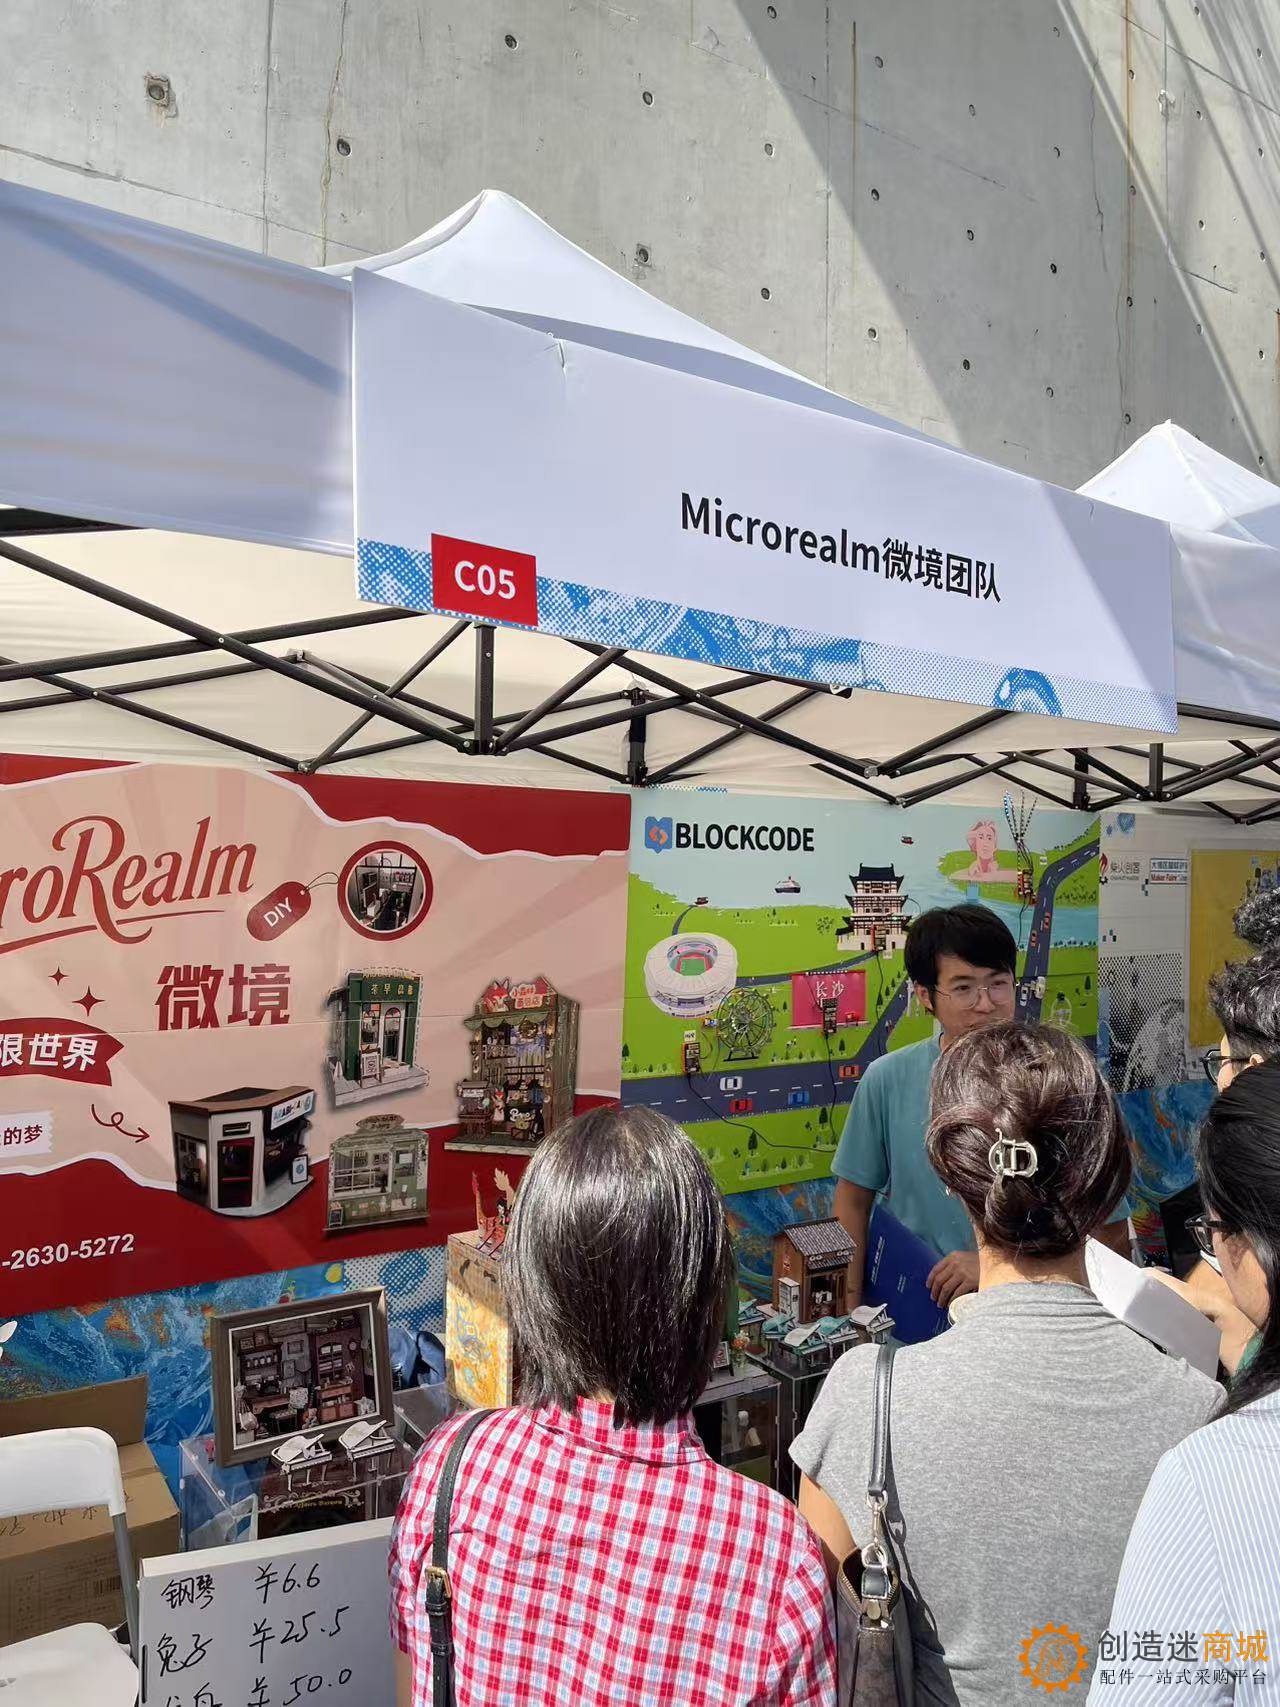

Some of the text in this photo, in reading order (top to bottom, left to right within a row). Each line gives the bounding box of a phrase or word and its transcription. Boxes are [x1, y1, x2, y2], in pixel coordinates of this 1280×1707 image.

[680, 492, 1001, 604] Microrealm微境团队
[454, 560, 516, 601] C05
[675, 822, 815, 853] BLOCKCODE
[263, 896, 292, 927] DIY
[156, 962, 291, 1031] 微境
[815, 980, 845, 998] 长沙
[0, 1032, 98, 1072] 限世界
[0, 1124, 43, 1146] 的梦
[254, 1562, 321, 1605] ¥6.6
[156, 1605, 350, 1678] 兔子 ¥25.5
